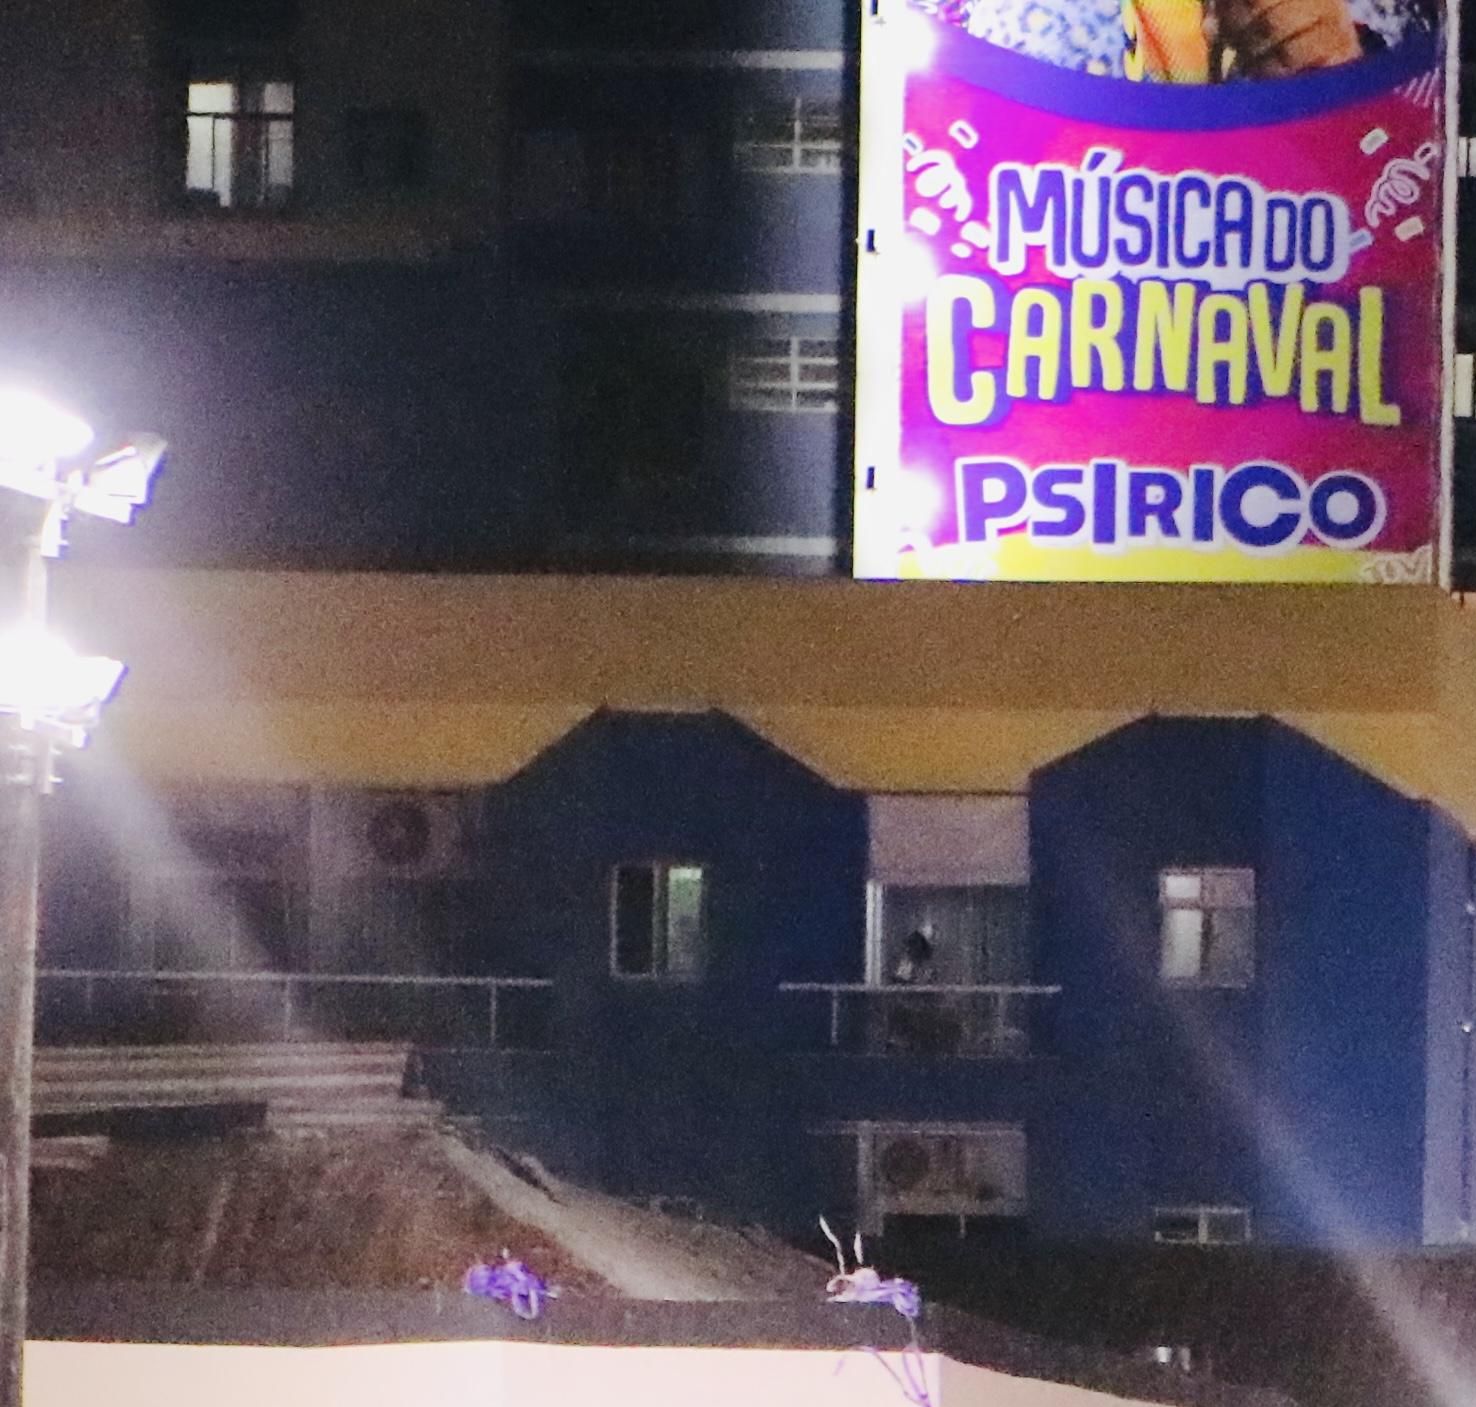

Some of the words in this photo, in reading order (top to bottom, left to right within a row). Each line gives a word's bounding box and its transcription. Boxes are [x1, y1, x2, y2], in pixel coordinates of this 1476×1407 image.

[996, 153, 1256, 270] MÚSICA
[1264, 198, 1336, 272] DO
[926, 275, 1401, 426] CARNAVAL
[962, 460, 1378, 548] PSIRICO
